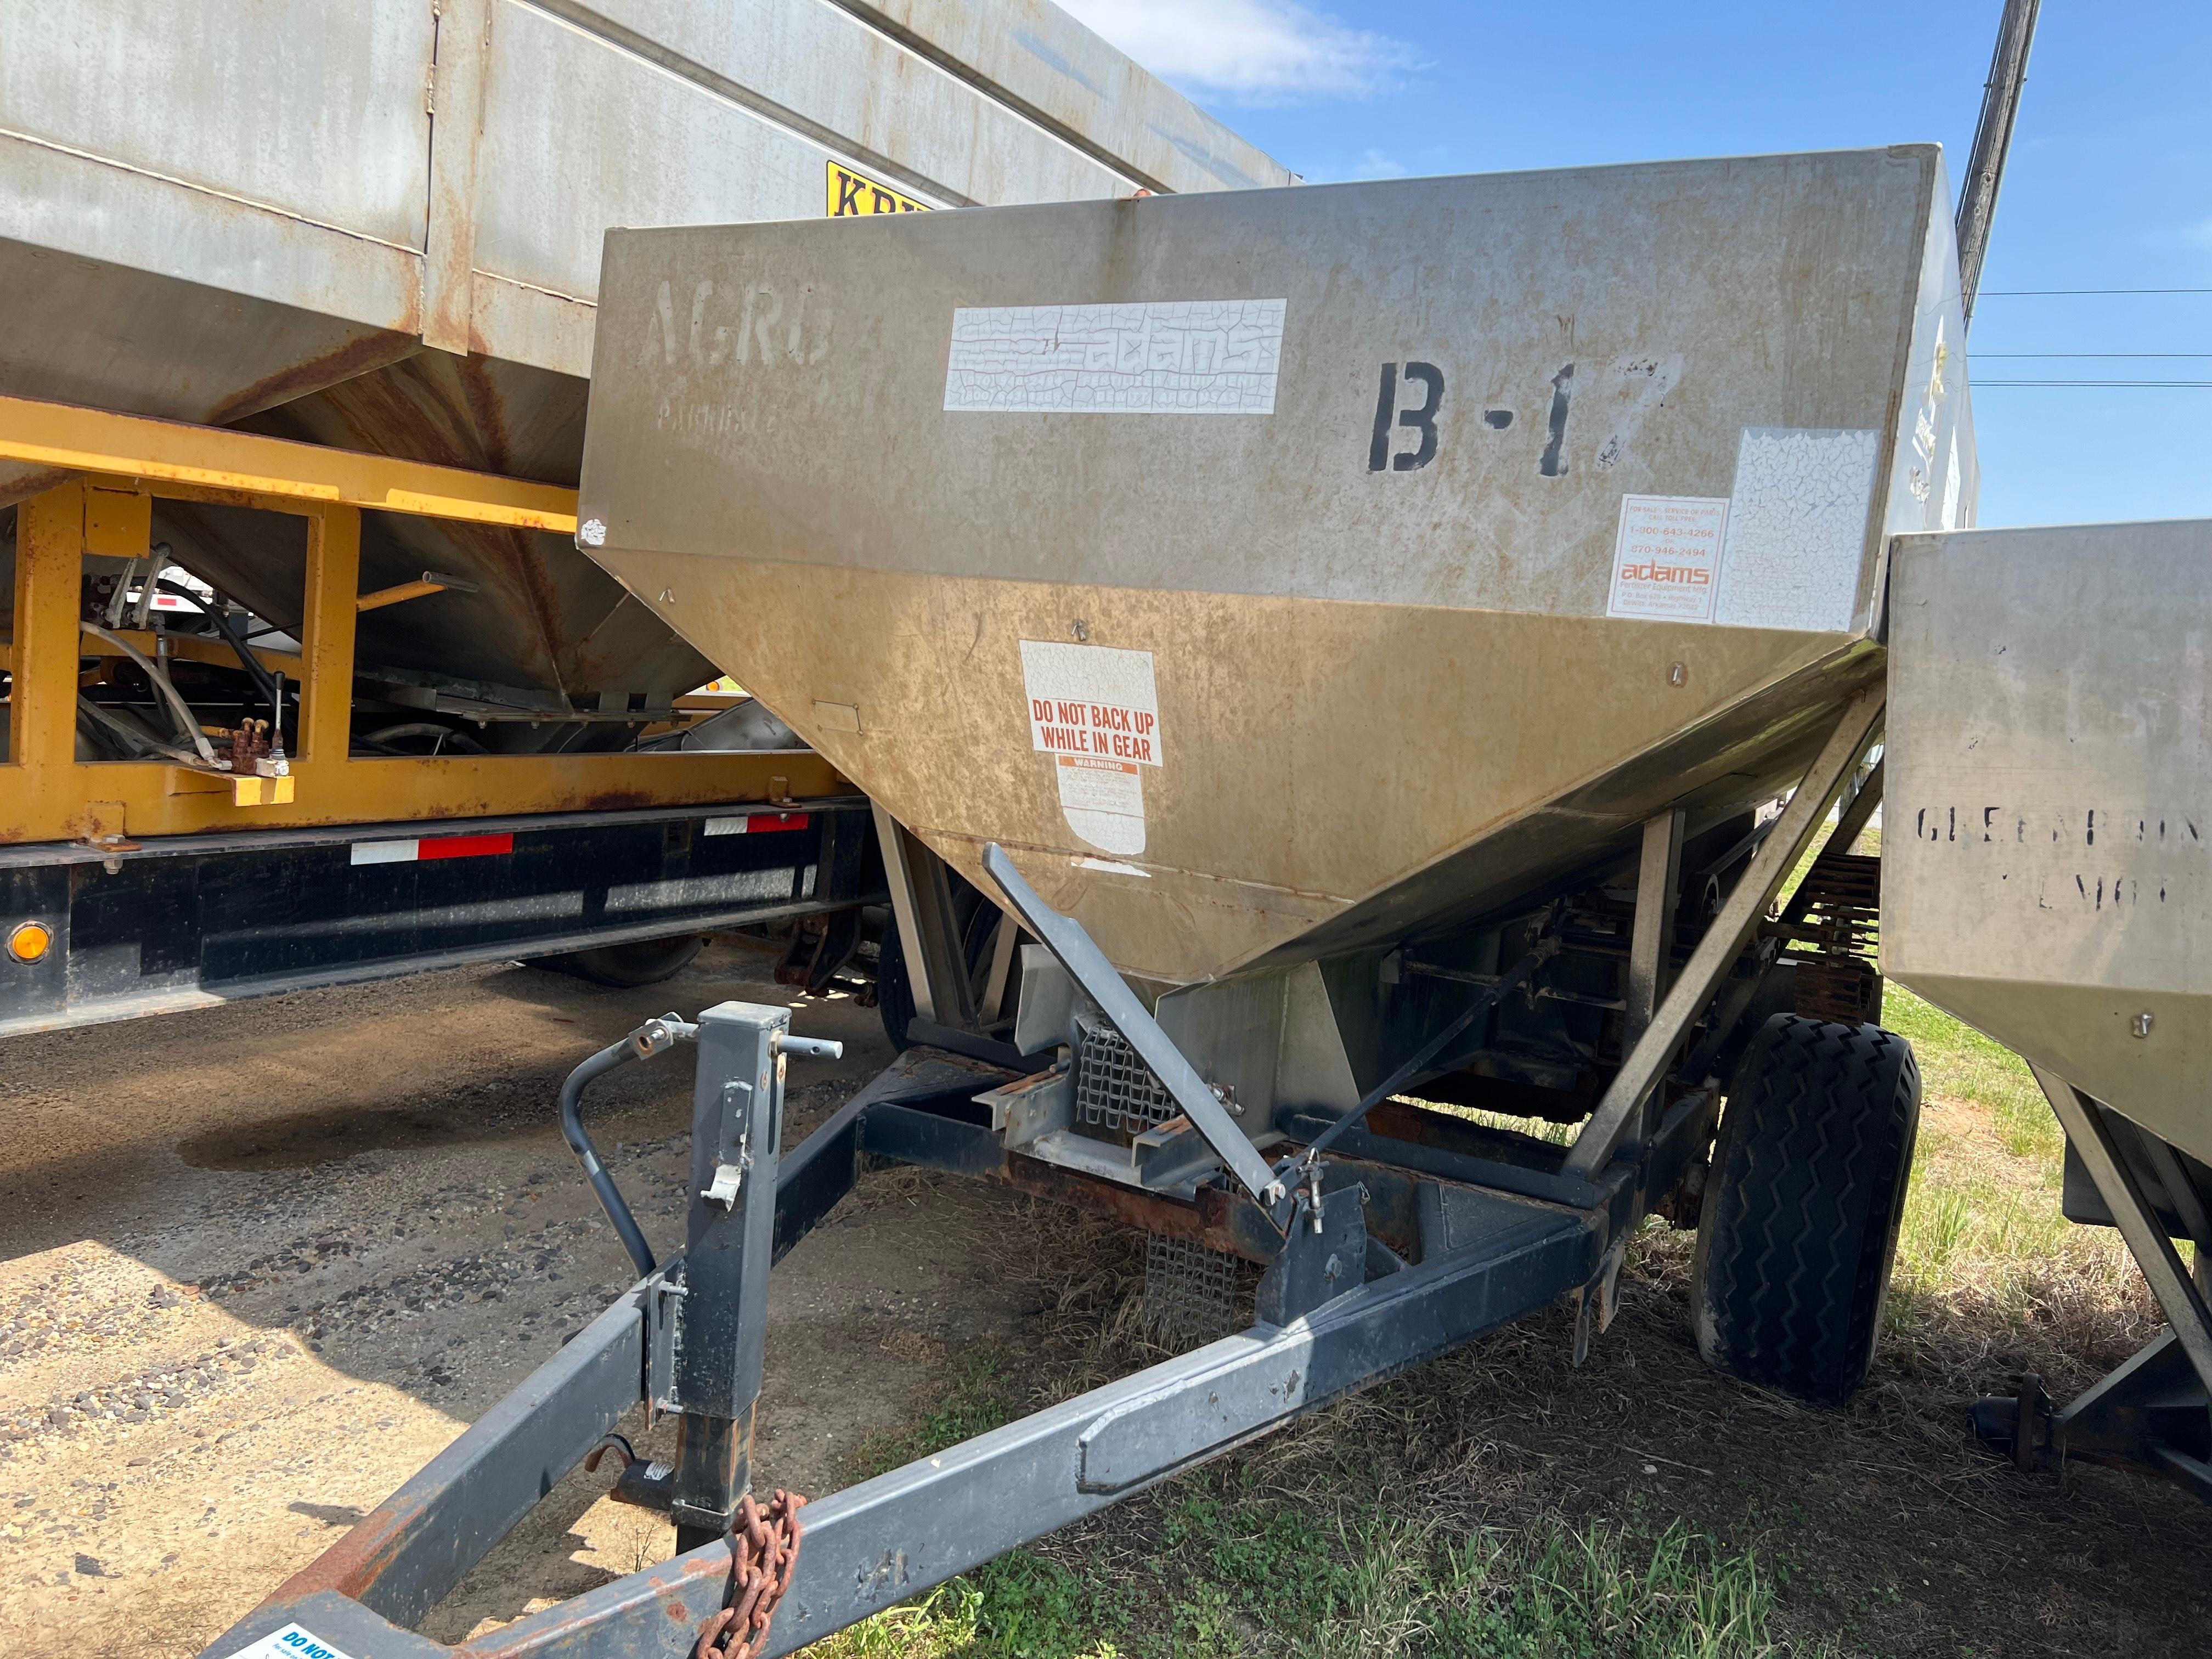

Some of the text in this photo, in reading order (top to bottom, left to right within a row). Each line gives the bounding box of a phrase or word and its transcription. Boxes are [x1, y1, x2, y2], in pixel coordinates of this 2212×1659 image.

[1631, 545, 1706, 557] 870-946-2494
[1622, 558, 1709, 584] adams
[1620, 581, 1651, 590] Fertilizer
[1652, 583, 1690, 592] Equipment
[1032, 699, 1154, 735] DO NOT BACK UP
[1041, 726, 1152, 761] WHILE IN GEAR
[1074, 758, 1124, 771] WARNING
[281, 1632, 336, 1659] DO NOT
